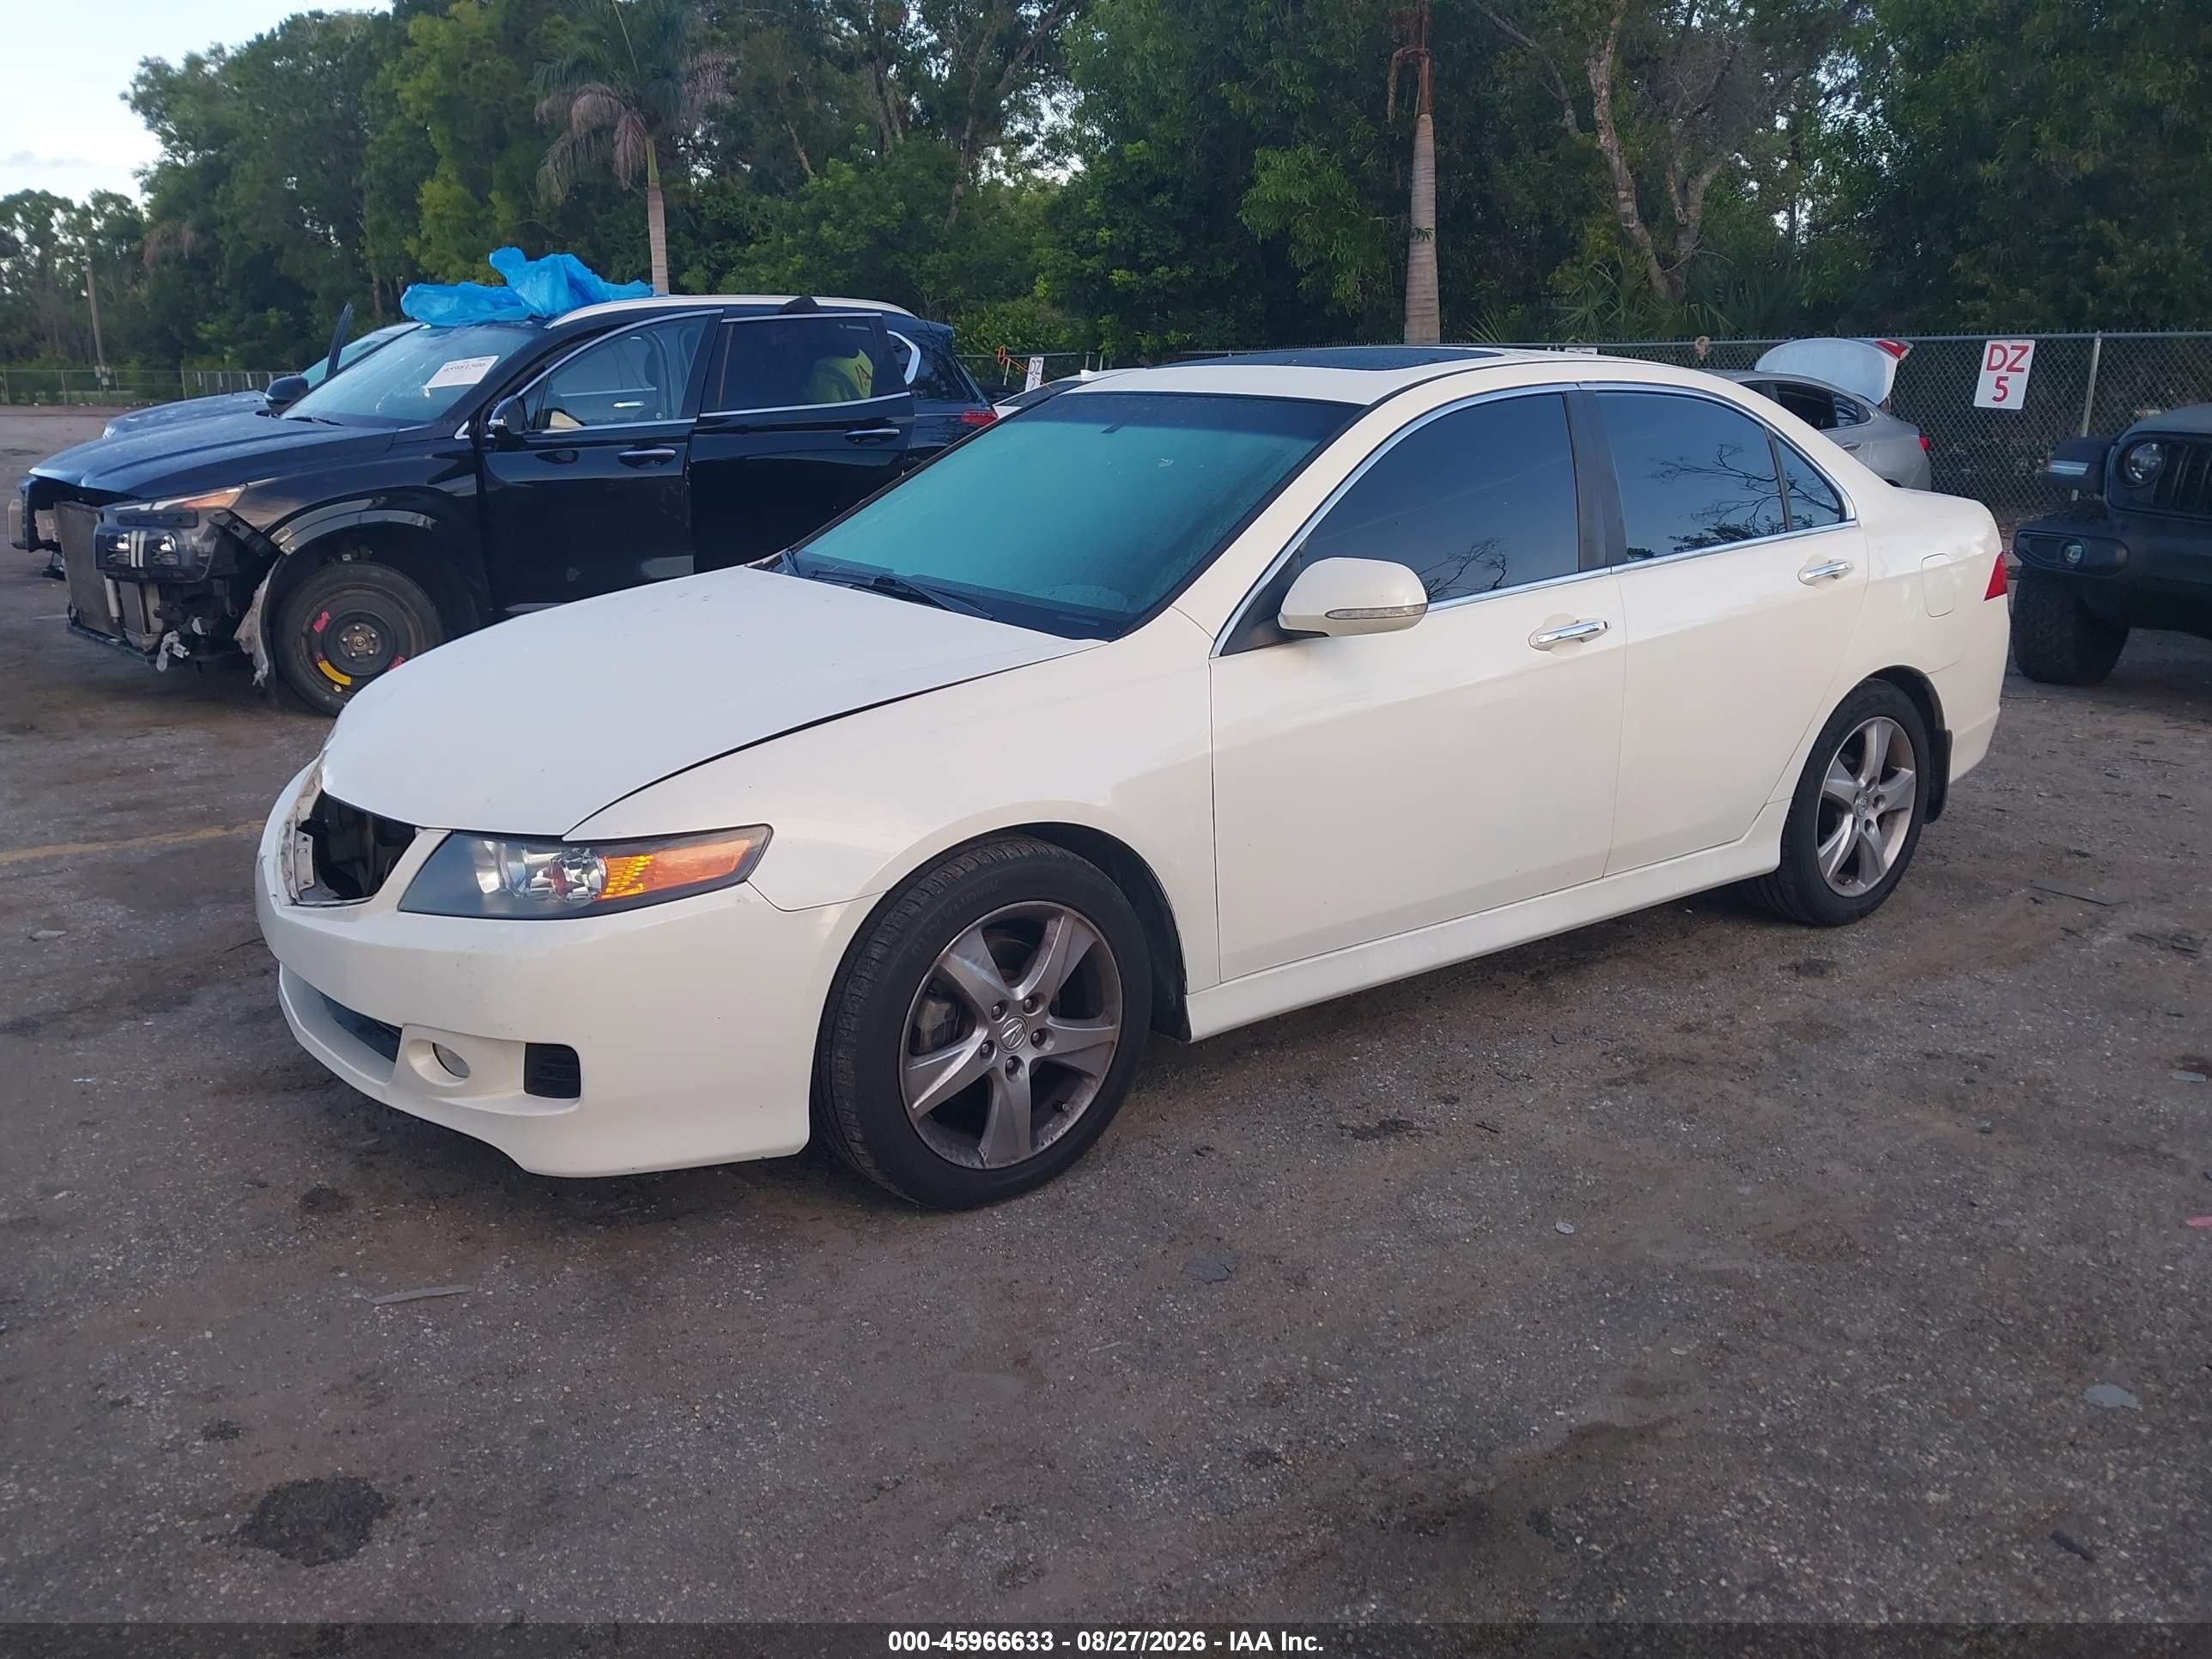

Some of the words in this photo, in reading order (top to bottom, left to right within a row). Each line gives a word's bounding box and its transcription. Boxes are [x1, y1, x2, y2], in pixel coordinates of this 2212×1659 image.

[1029, 360, 1042, 374] DZ
[1986, 344, 2030, 373] DZ
[1991, 376, 2009, 403] 5
